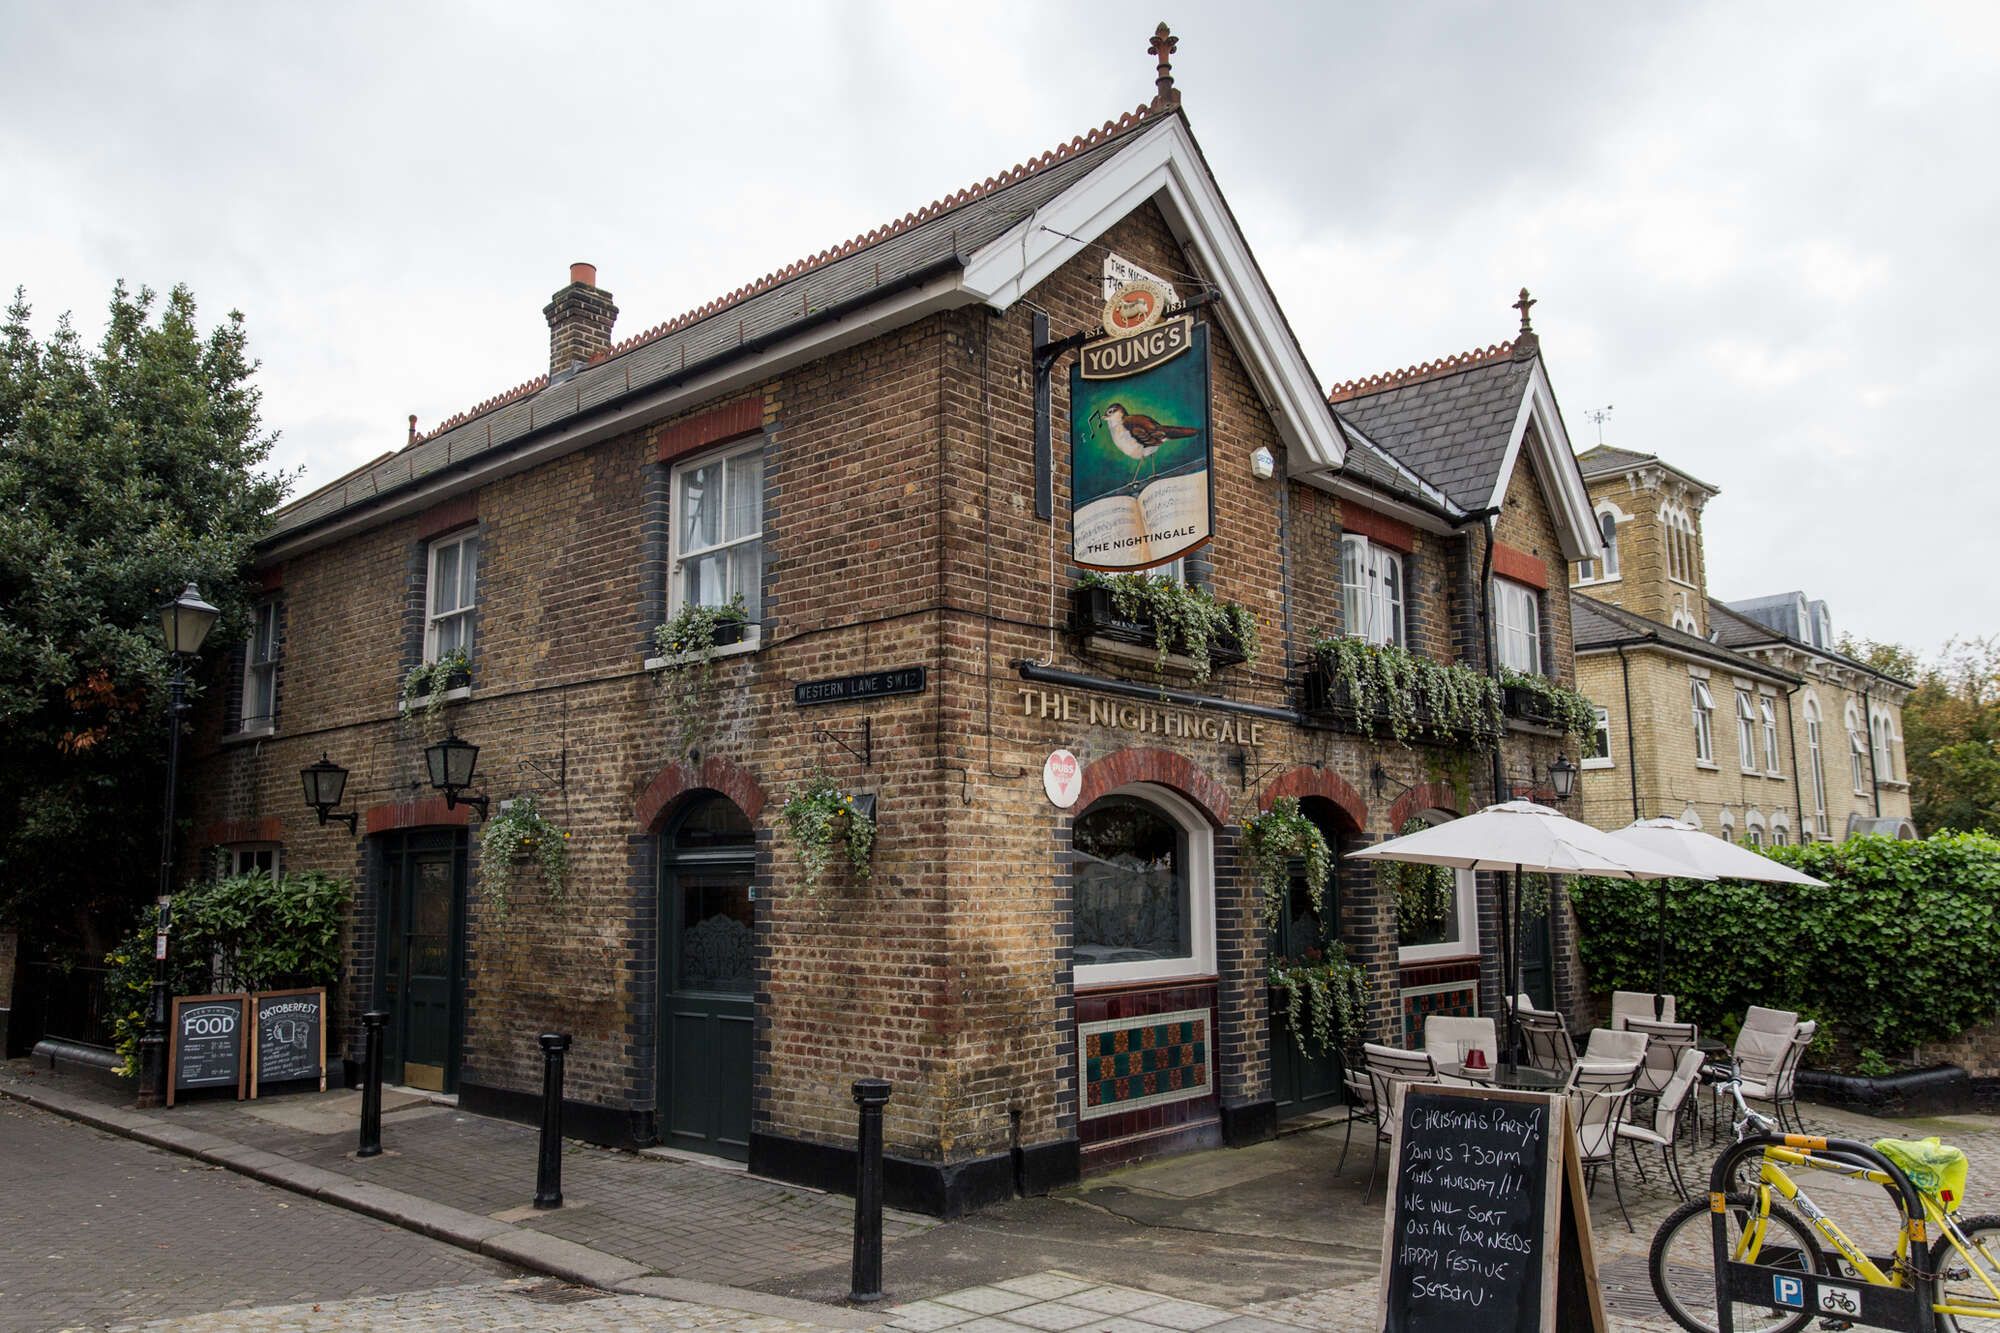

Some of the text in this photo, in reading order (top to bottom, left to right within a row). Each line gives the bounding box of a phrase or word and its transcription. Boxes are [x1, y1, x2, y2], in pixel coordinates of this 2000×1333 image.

[1166, 300, 1187, 313] 1831
[1089, 325, 1182, 371] YOUNG'S
[1087, 525, 1196, 554] THE NIGHTINGALE
[799, 673, 917, 699] WESTERN LANE SW12
[1018, 688, 1265, 747] THE NIGHTINGALE
[259, 1003, 319, 1020] OKTOBERFEST
[184, 1017, 235, 1036] FOOD
[1406, 1141, 1432, 1161] JOIN
[1436, 1148, 1453, 1162] US
[1406, 1164, 1433, 1184] THIS
[1404, 1193, 1507, 1226] WE WILL SORT
[1433, 1219, 1453, 1236] ALL
[1458, 1224, 1484, 1247] YOUR
[1488, 1232, 1532, 1254] NEEDS
[1400, 1244, 1509, 1280] HAPPY FESTIVE
[1781, 1281, 1798, 1302] P
